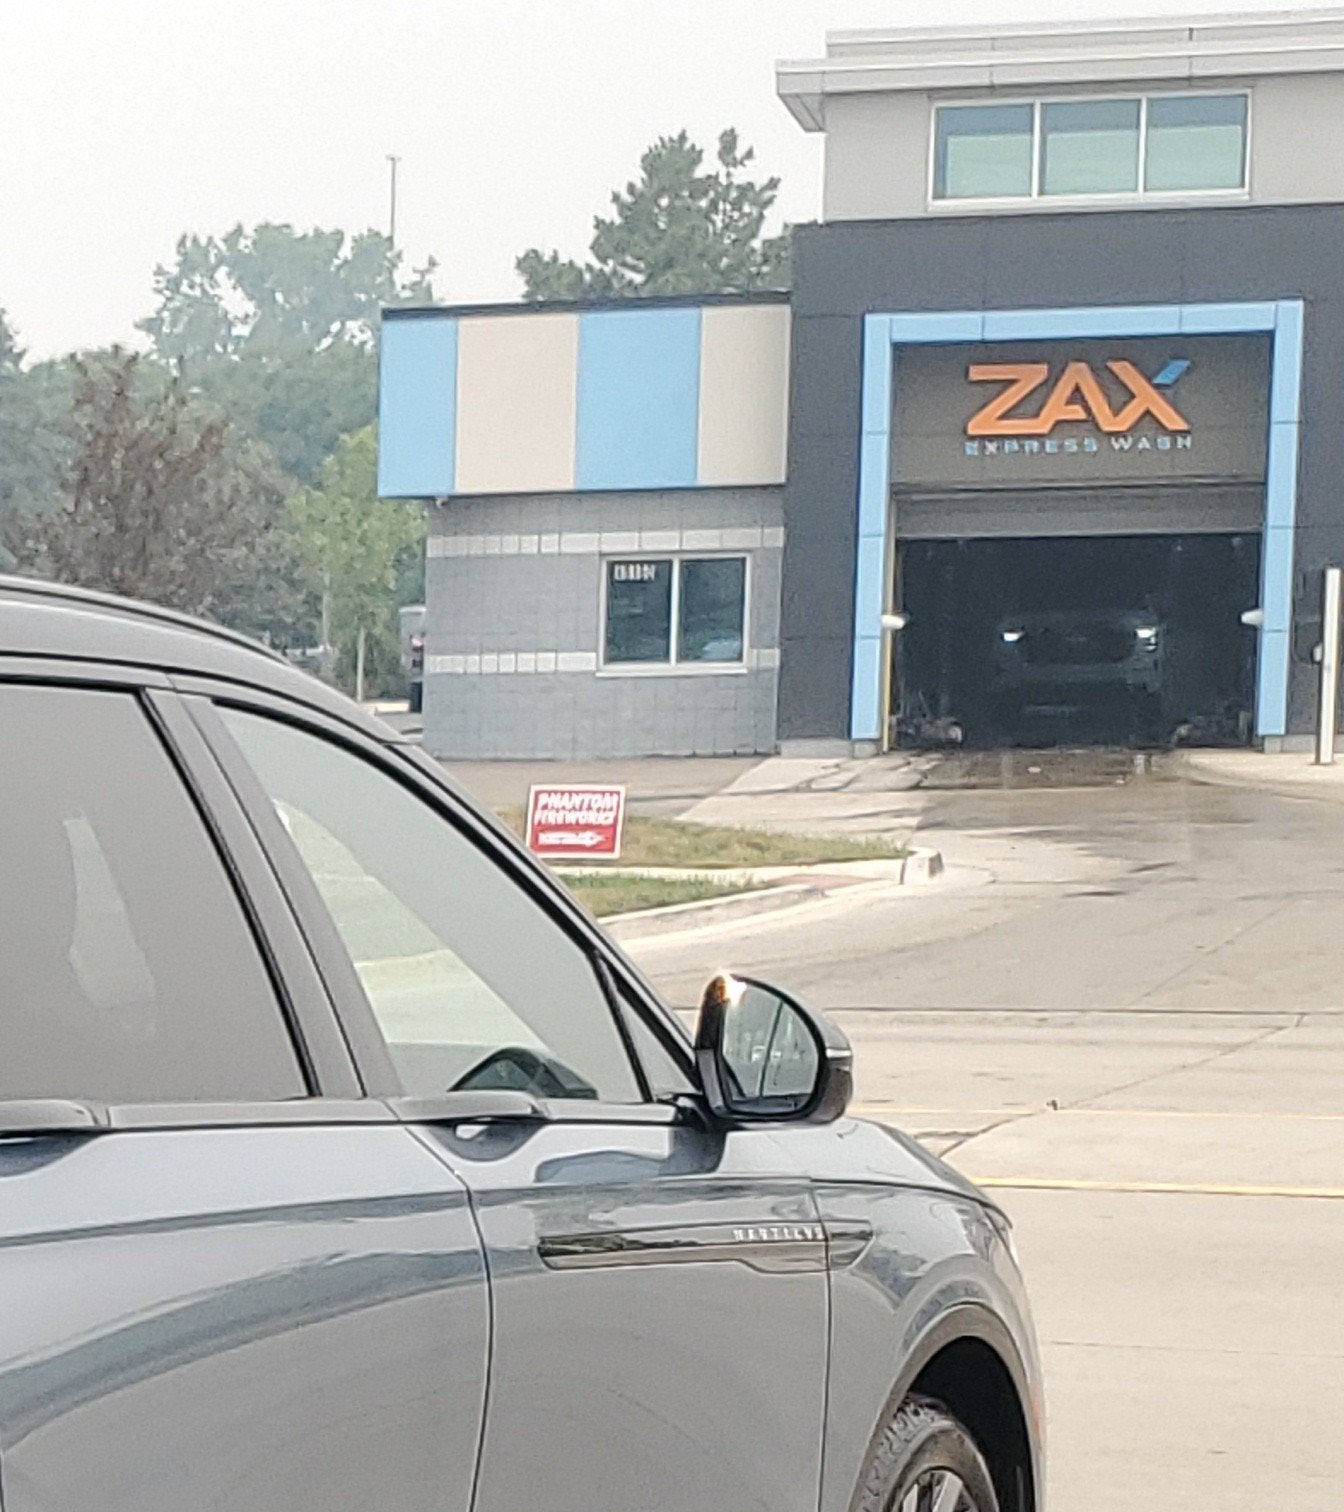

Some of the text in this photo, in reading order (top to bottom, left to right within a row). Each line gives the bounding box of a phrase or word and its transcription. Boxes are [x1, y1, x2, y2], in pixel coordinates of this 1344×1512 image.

[967, 359, 1191, 435] ZAX
[964, 434, 1192, 456] EXPRESS WASH
